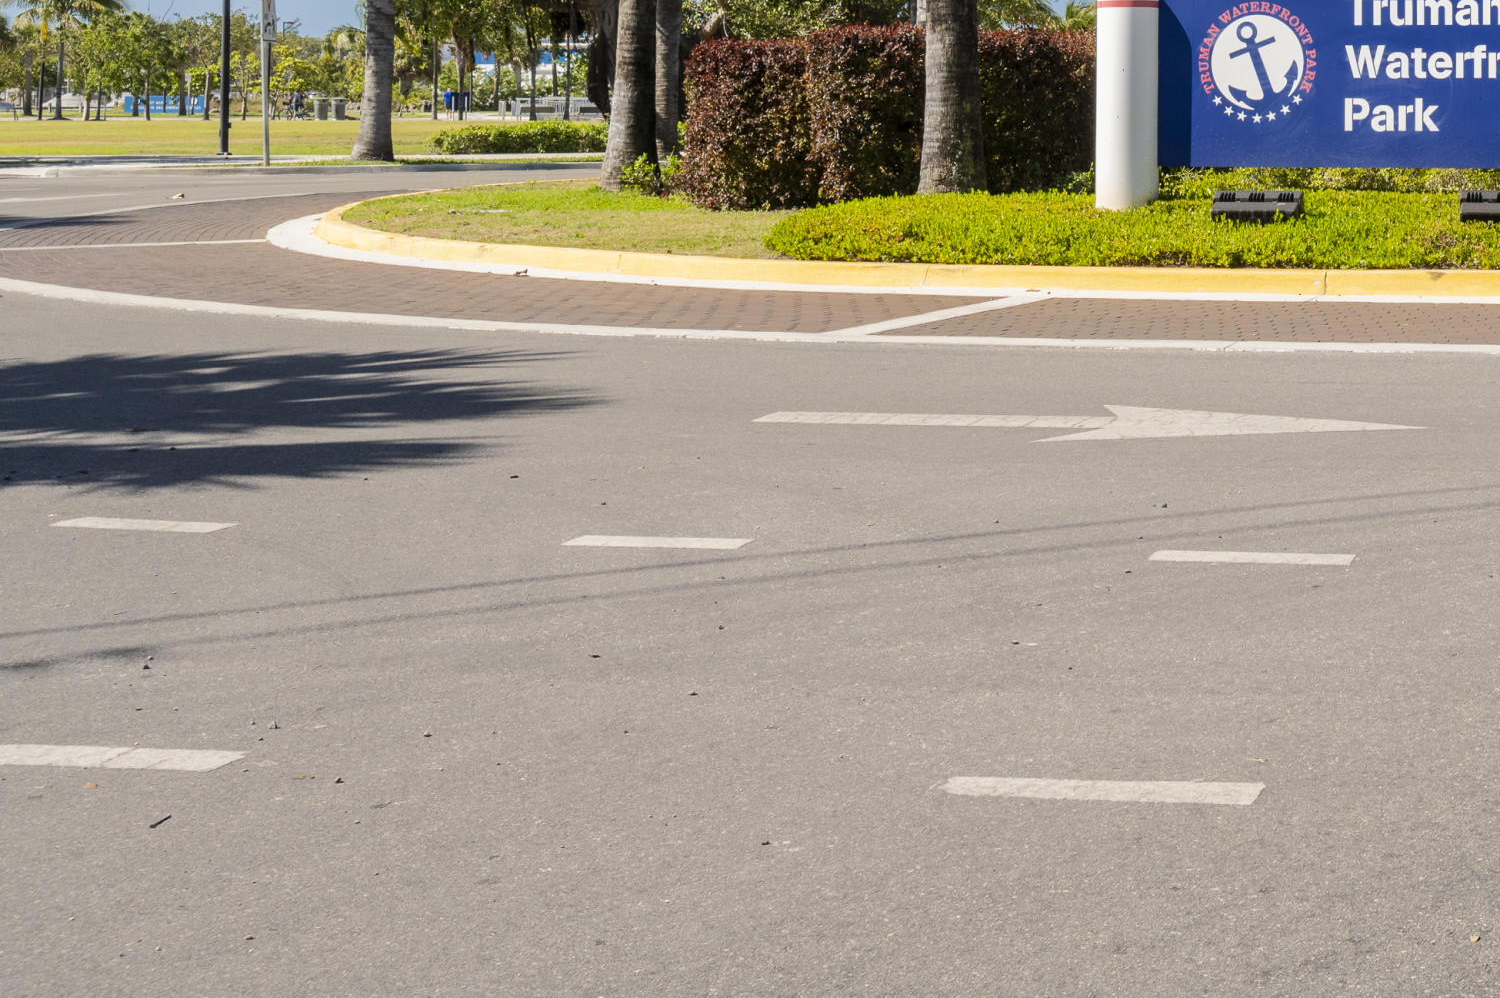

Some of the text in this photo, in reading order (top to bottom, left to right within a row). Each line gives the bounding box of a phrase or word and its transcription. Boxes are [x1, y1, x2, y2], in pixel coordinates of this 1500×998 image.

[1198, 1, 1317, 95] TRUMAN WATERFRONT PARK
[1344, 97, 1440, 133] Park
